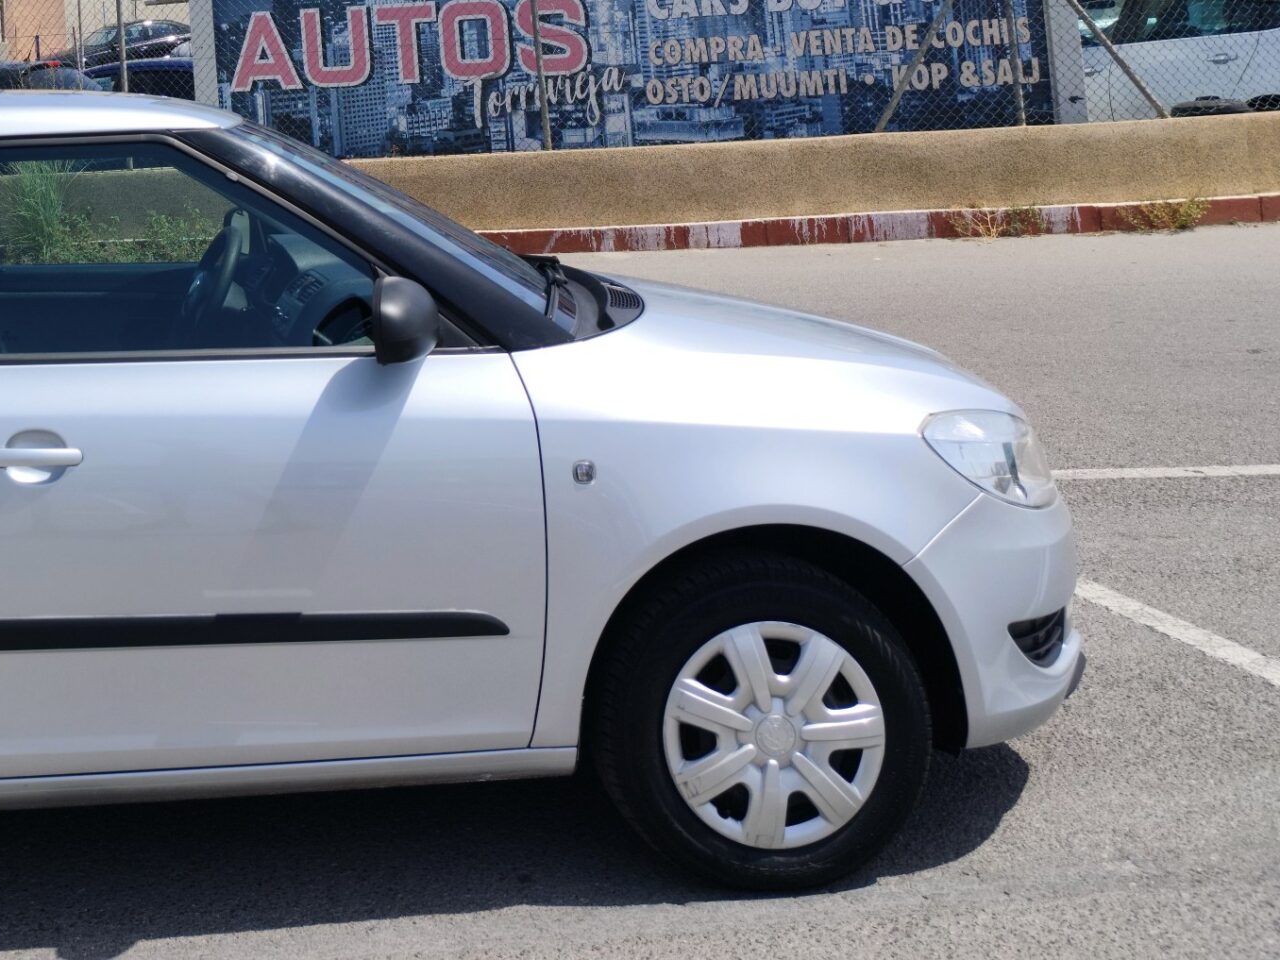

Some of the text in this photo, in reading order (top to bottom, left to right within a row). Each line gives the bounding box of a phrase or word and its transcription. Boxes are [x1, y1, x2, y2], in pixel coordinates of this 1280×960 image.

[648, 33, 765, 67] COMPRA
[790, 27, 876, 57] VENTA
[885, 23, 920, 52] DE
[464, 63, 624, 129] Torrvieja
